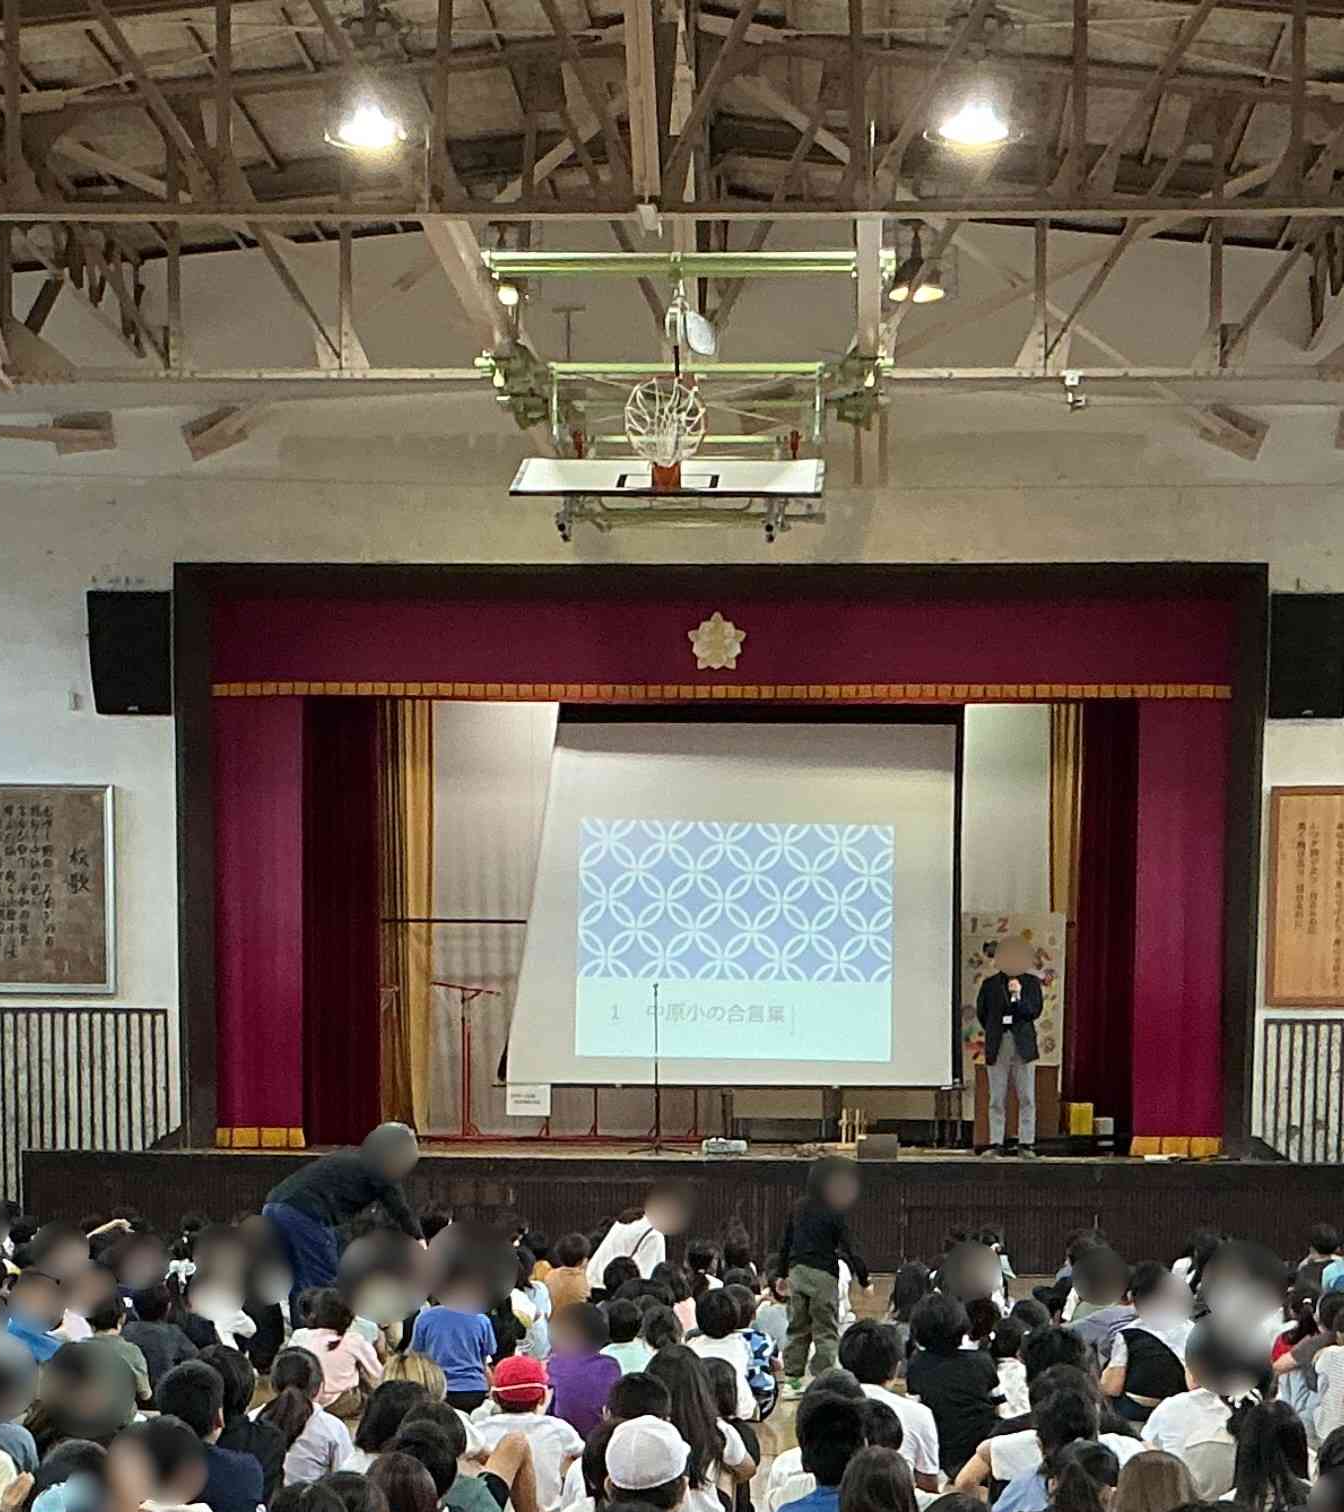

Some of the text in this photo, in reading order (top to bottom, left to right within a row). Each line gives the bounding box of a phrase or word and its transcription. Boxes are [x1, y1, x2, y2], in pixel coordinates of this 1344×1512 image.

[645, 1003, 785, 1024] 中原小の合言葉
